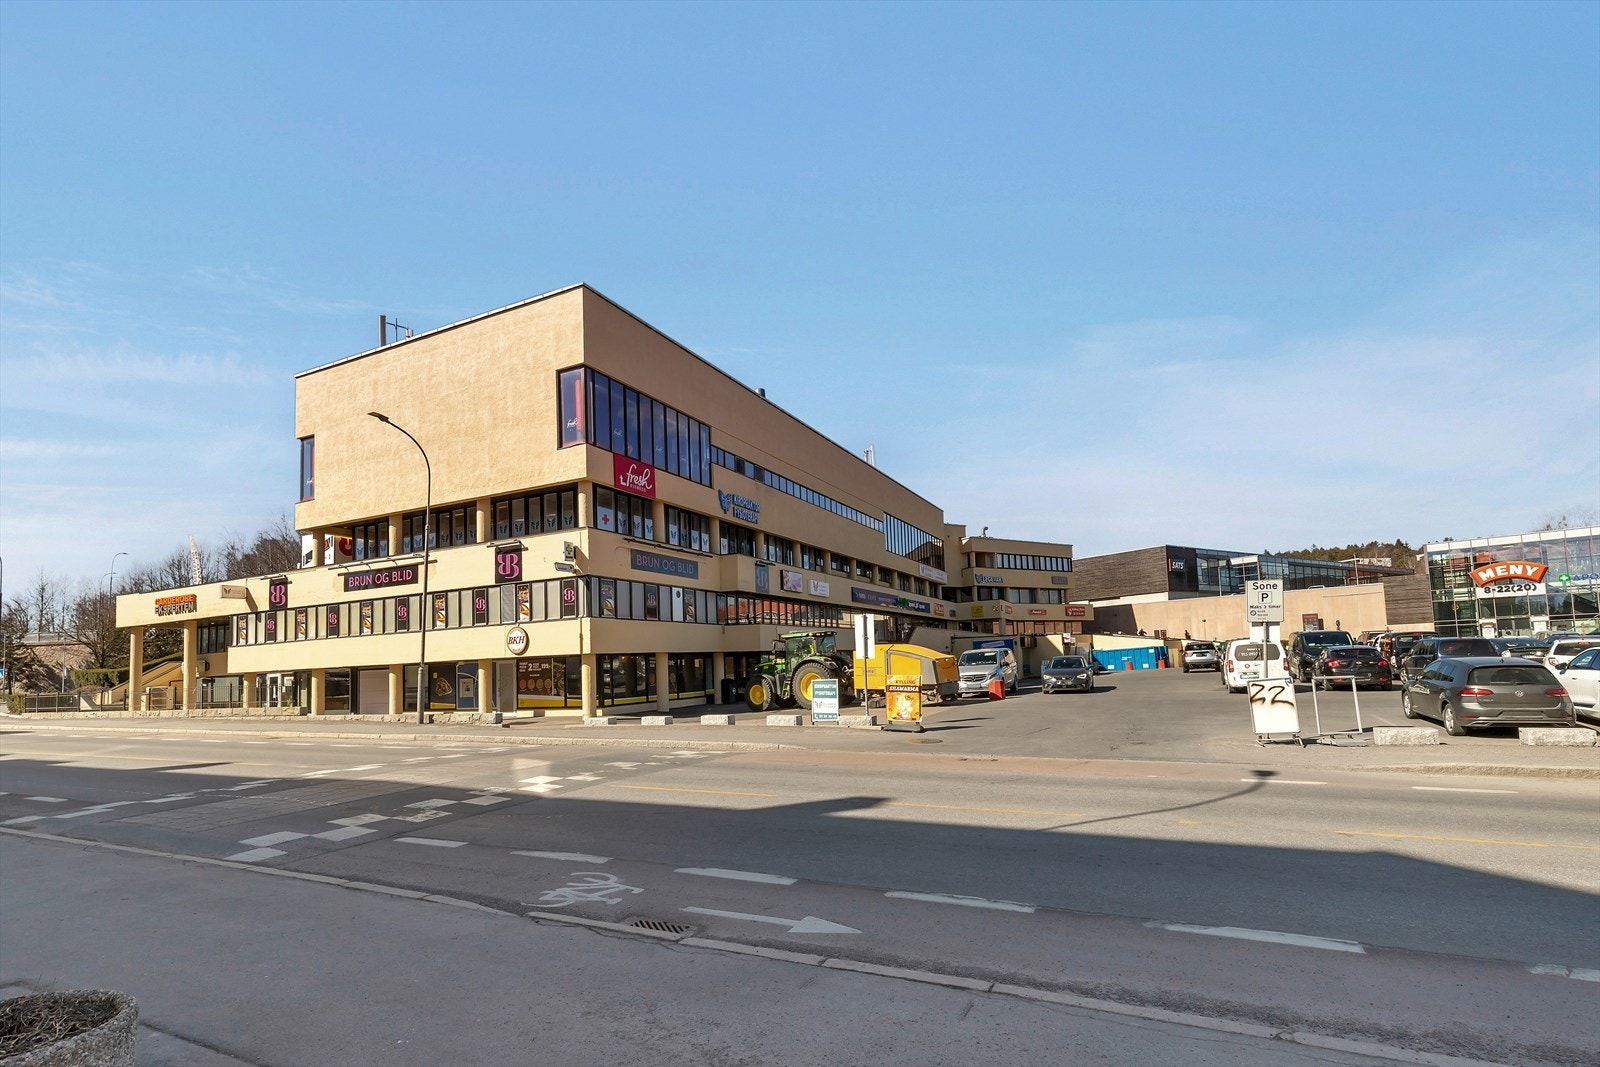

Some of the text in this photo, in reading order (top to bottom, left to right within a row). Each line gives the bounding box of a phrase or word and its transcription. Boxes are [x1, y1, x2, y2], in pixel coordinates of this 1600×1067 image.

[626, 464, 652, 490] fresh
[636, 554, 694, 574] BRUN OG BLID
[1172, 561, 1184, 570] SATS
[348, 569, 413, 587] BRUN OG BLID
[1477, 564, 1540, 582] MENY
[1252, 582, 1278, 591] Sone
[1484, 583, 1537, 594] 8-22(20)
[1261, 593, 1269, 602] P
[155, 602, 194, 614] EKSPERTEN
[508, 635, 525, 645] BKH
